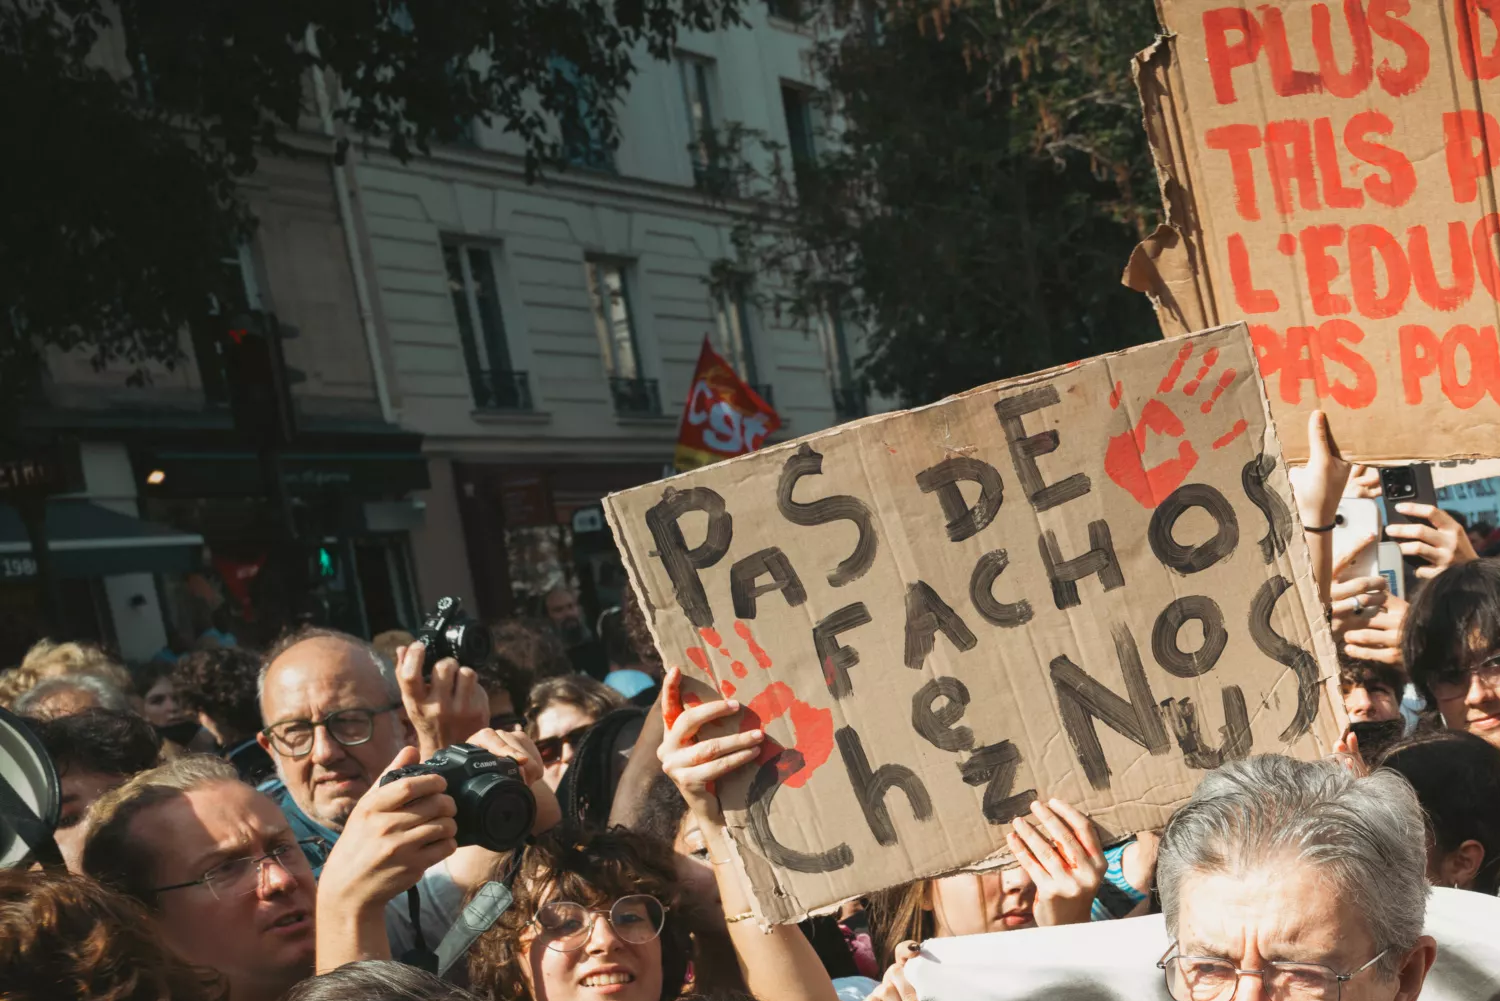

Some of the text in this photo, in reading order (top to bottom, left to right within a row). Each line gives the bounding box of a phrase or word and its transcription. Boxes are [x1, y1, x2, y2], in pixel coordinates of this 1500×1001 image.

[1203, 0, 1430, 104] PLUS
[1250, 319, 1377, 409] PAS
[647, 384, 1092, 627] PAS DE
[812, 452, 1301, 699] FACHOS
[473, 760, 497, 769] Canon
